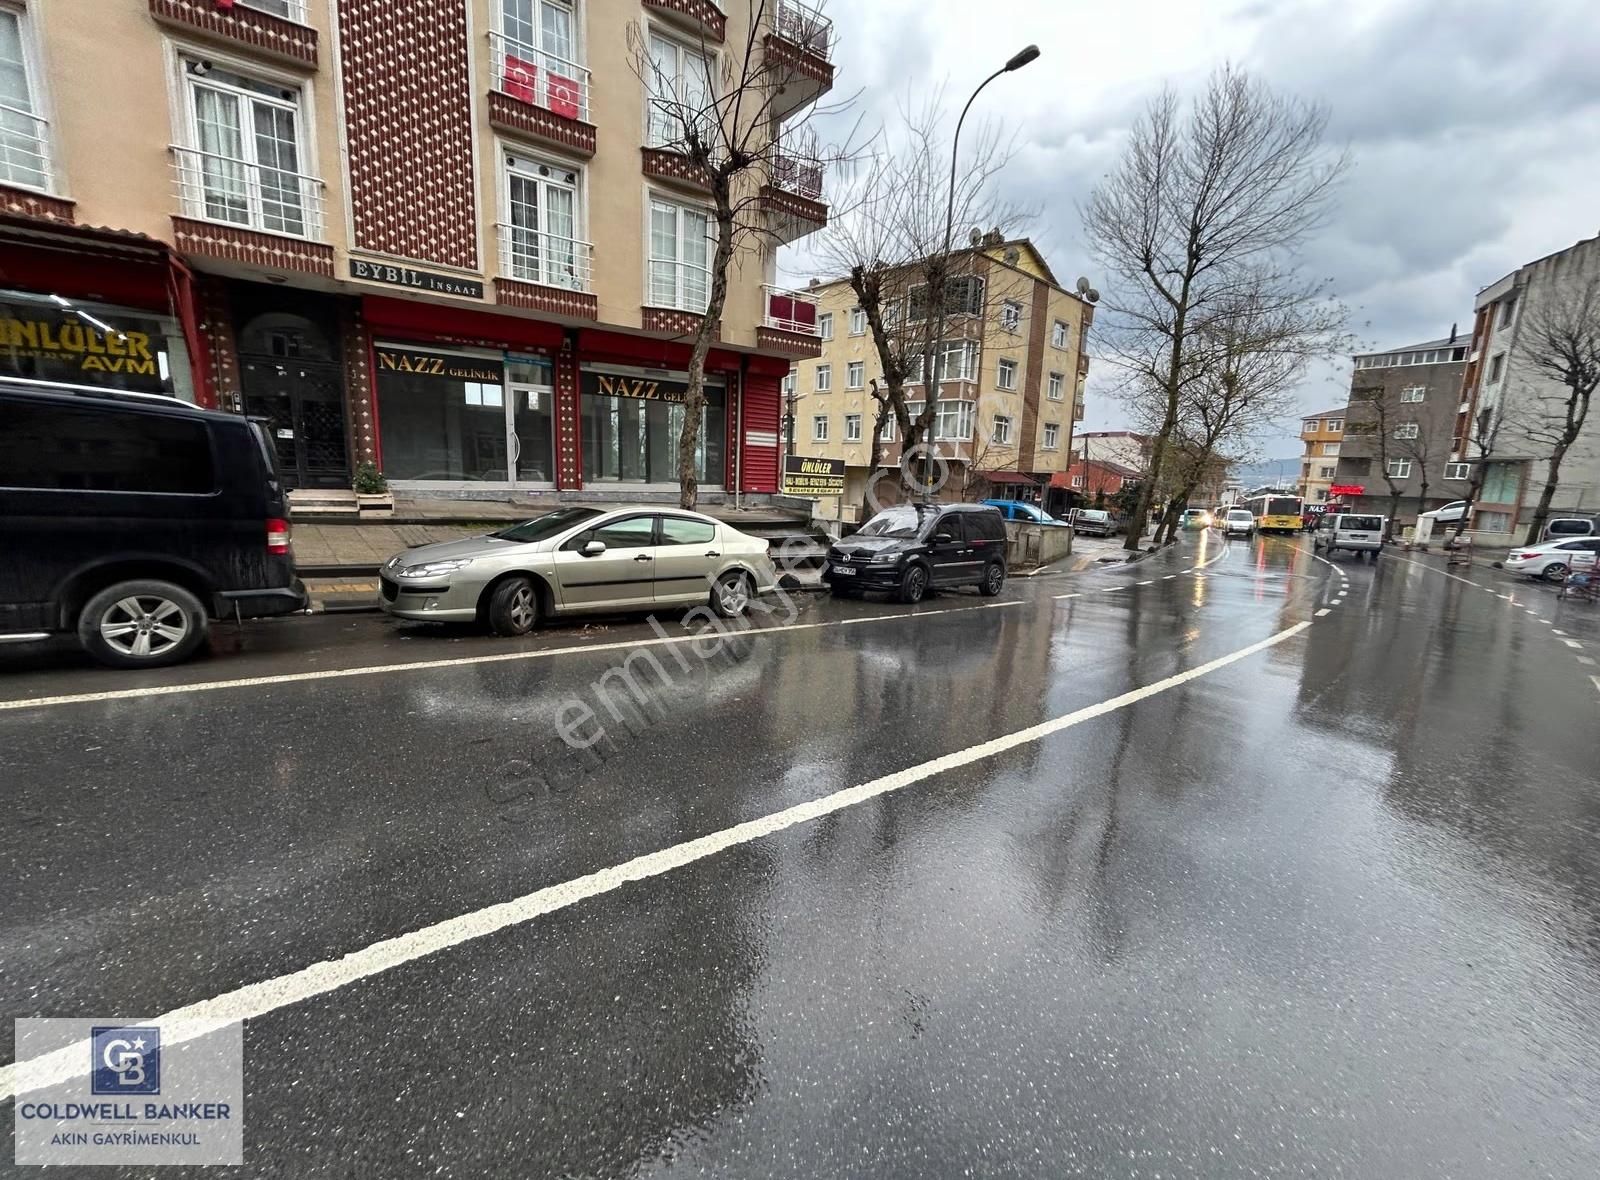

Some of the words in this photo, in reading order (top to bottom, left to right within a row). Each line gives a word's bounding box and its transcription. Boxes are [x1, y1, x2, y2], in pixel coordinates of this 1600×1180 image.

[355, 261, 422, 286] EYBİL
[430, 278, 477, 296] İNŞAAT
[81, 355, 156, 375] AVM
[379, 352, 445, 375] NAZZ
[449, 367, 499, 381] GELİNLİK
[597, 375, 659, 400] NAZZ
[801, 459, 832, 474] ÜNLÜLER
